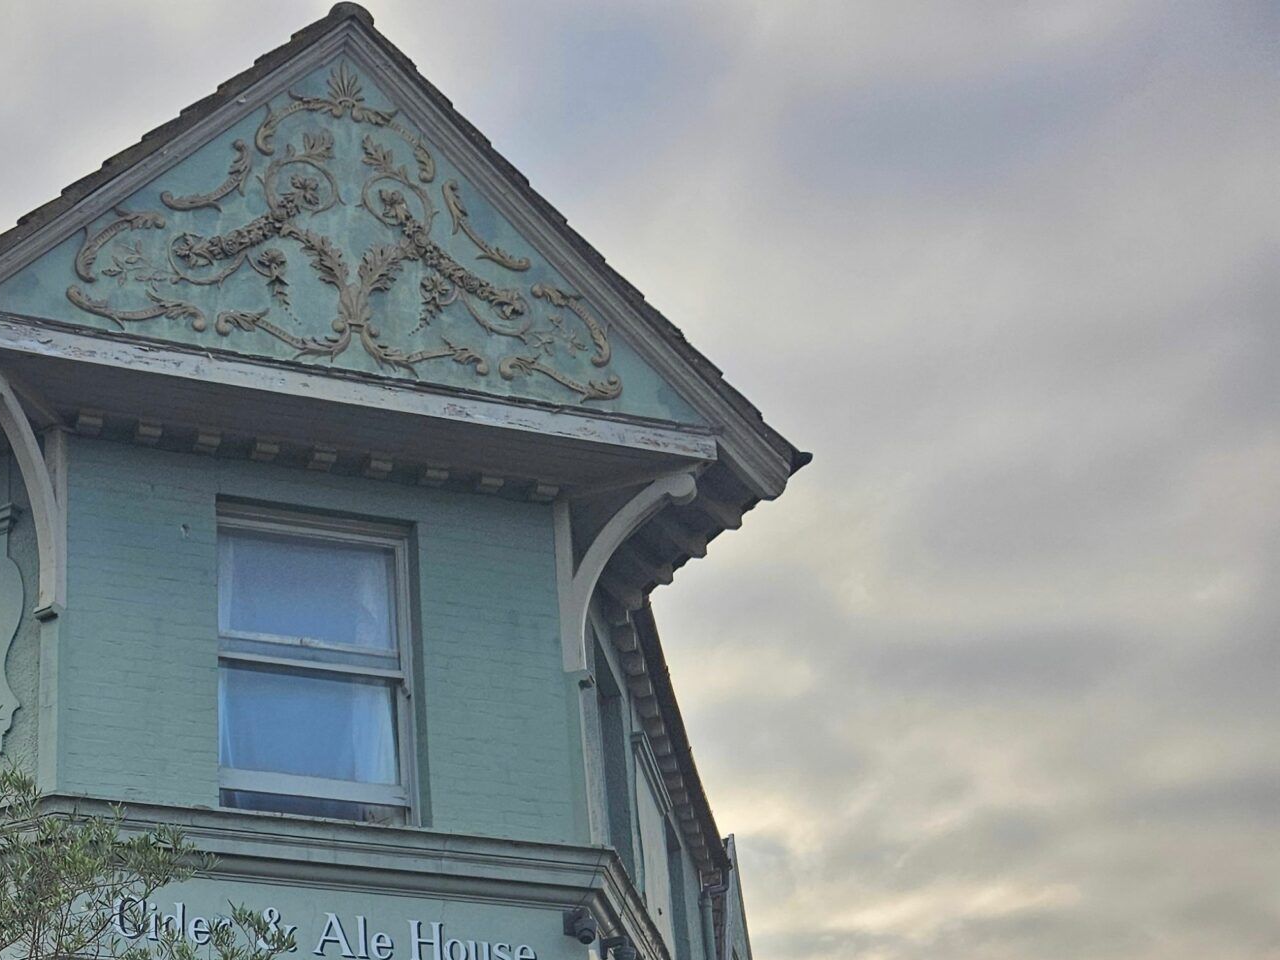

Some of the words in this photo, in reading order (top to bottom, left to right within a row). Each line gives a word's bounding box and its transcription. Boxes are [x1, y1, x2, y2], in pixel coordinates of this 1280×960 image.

[113, 896, 234, 946] Cider
[258, 906, 297, 952] &
[312, 911, 395, 960] Ale
